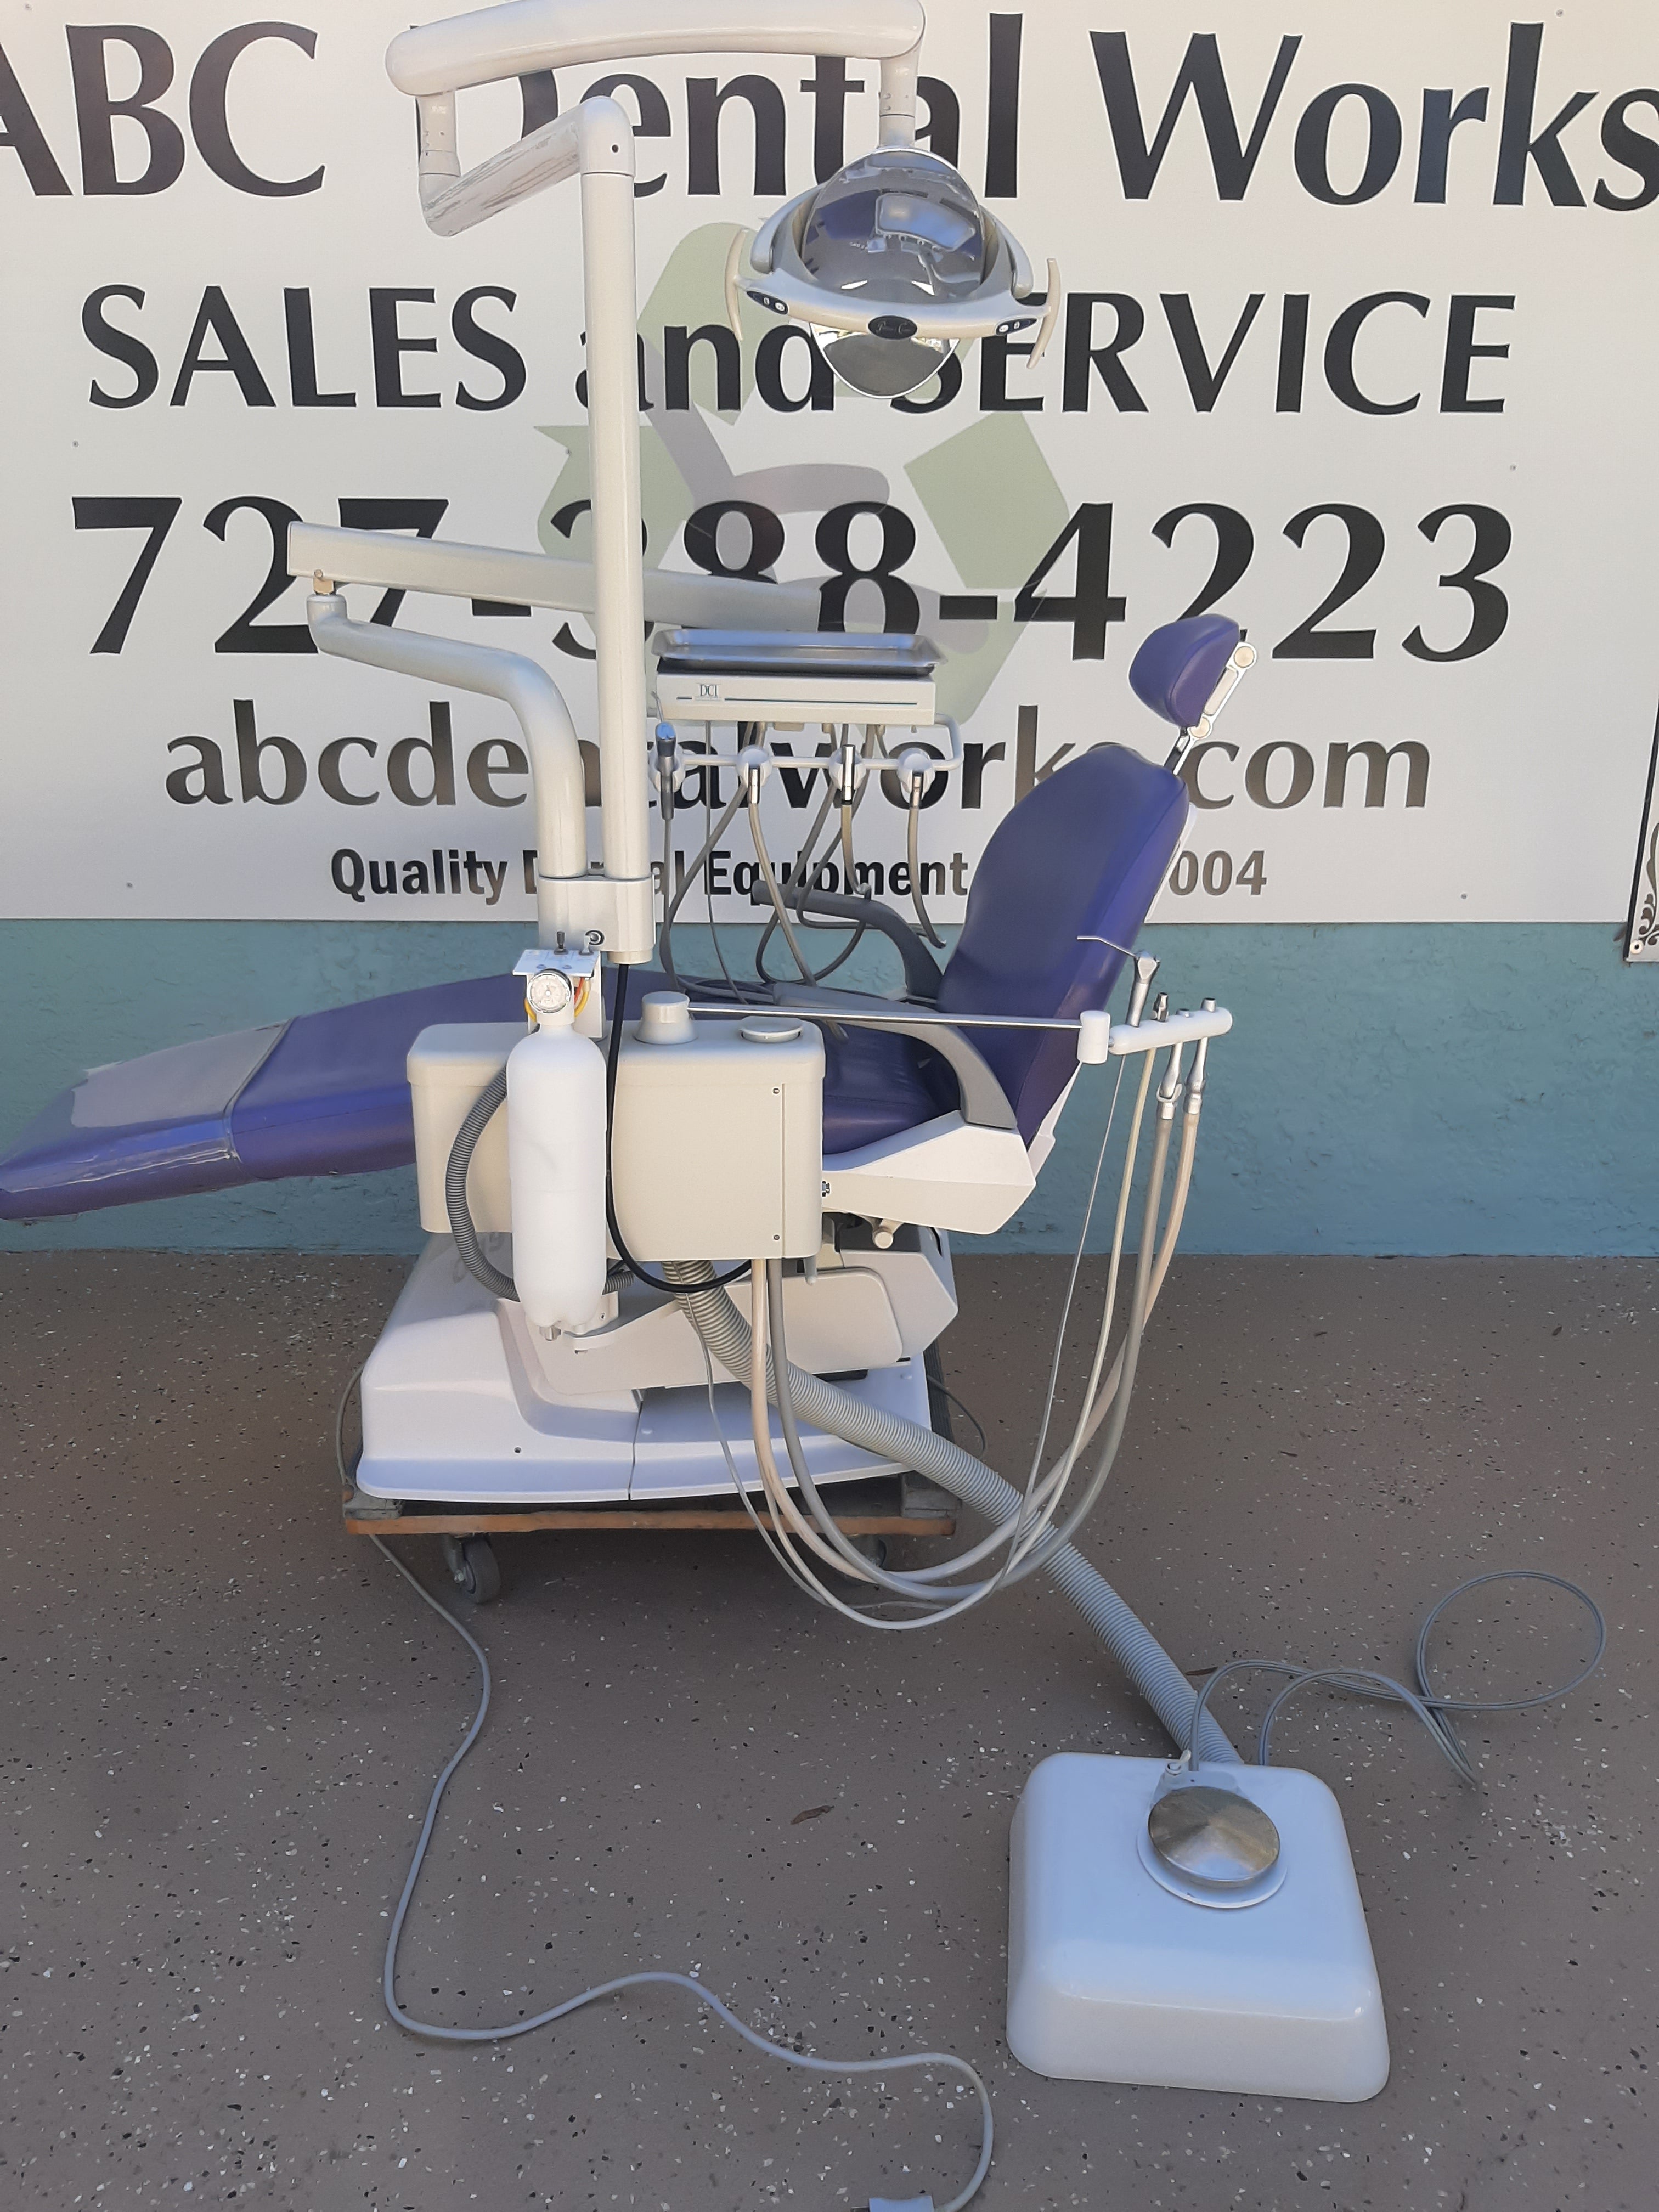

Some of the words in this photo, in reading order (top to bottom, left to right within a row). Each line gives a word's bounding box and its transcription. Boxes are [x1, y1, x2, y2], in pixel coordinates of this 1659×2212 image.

[410, 13, 1022, 198] ntl
[1090, 22, 1659, 211] Works
[82, 284, 527, 411] SALES
[576, 324, 834, 413] nd
[72, 495, 1511, 662] 727-88-4223
[699, 684, 718, 697] DCI
[331, 848, 508, 906] Quality
